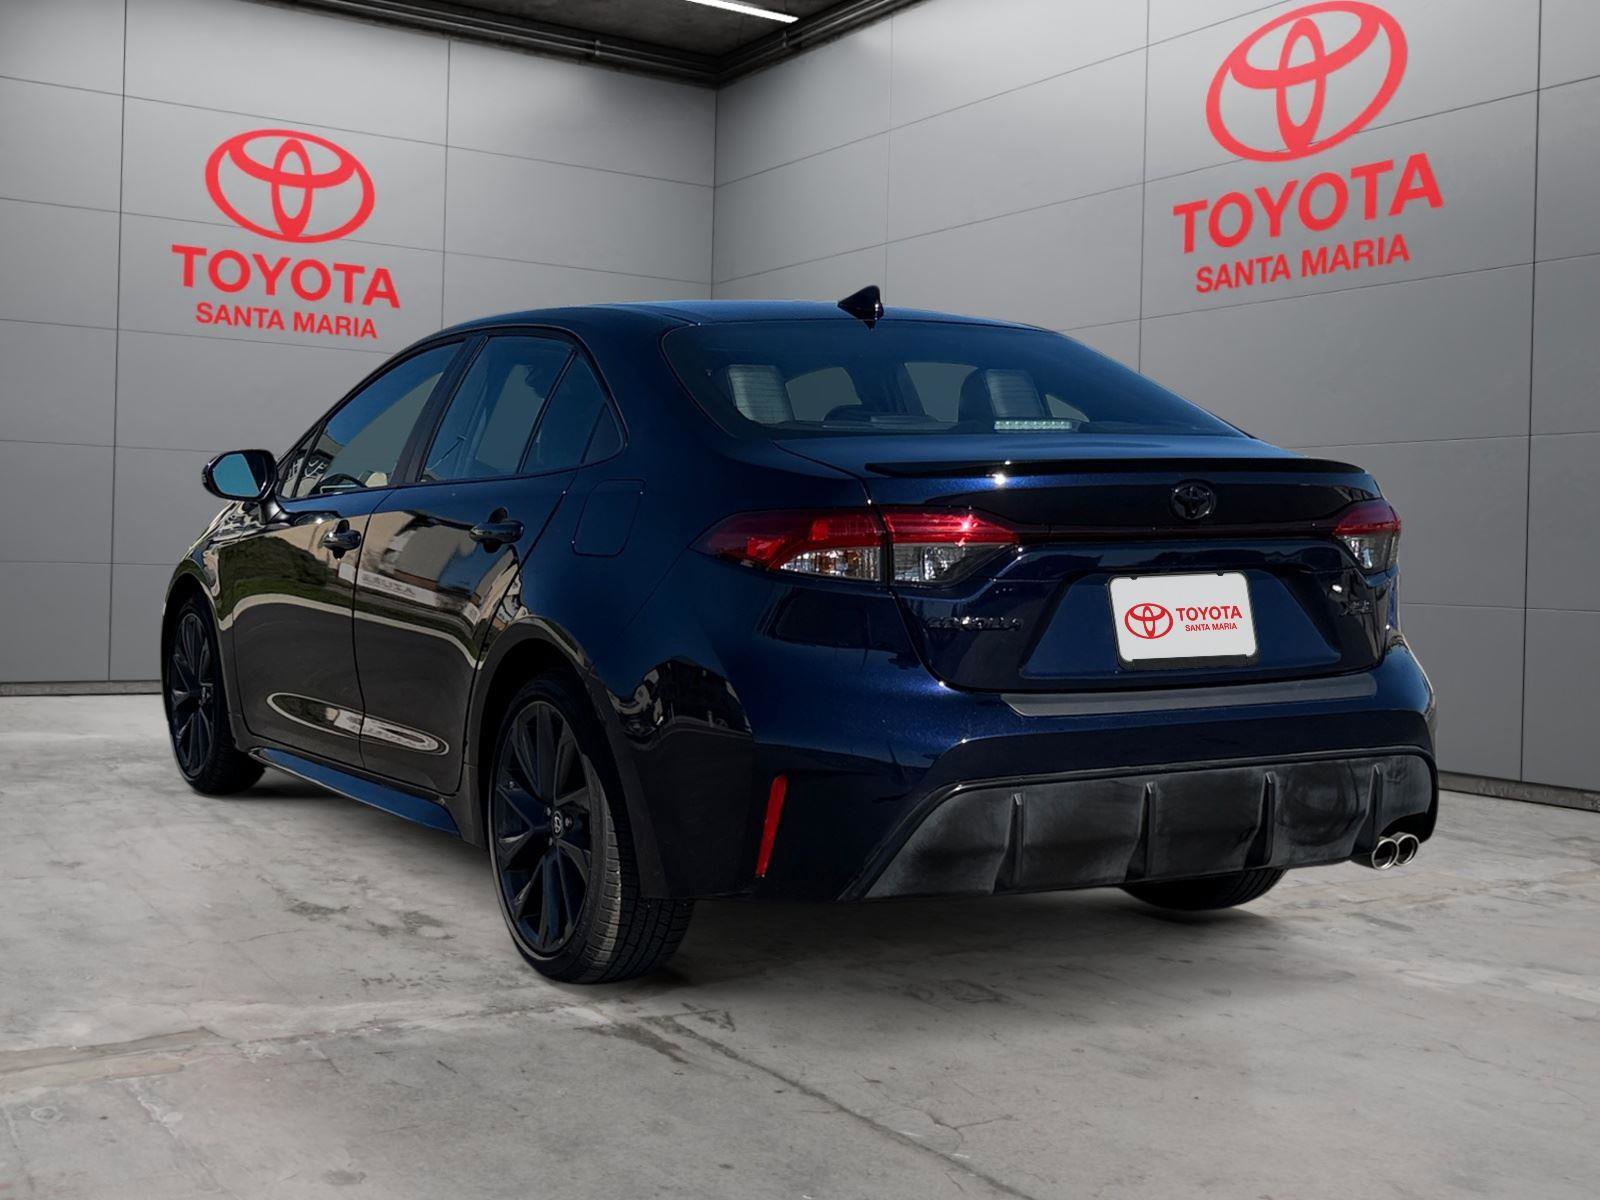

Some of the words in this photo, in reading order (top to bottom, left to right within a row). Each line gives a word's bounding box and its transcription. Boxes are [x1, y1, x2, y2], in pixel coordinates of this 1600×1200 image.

[1172, 152, 1443, 255] TOYOTA
[171, 244, 401, 309] TOYOTA
[1195, 254, 1291, 294] SANTA
[1301, 233, 1411, 278] MARIA
[195, 301, 285, 331] SANTA
[293, 311, 378, 340] MARIA
[1175, 605, 1243, 622] TOYOTA
[1185, 623, 1211, 632] SANTA
[1212, 622, 1238, 631] MARIA
